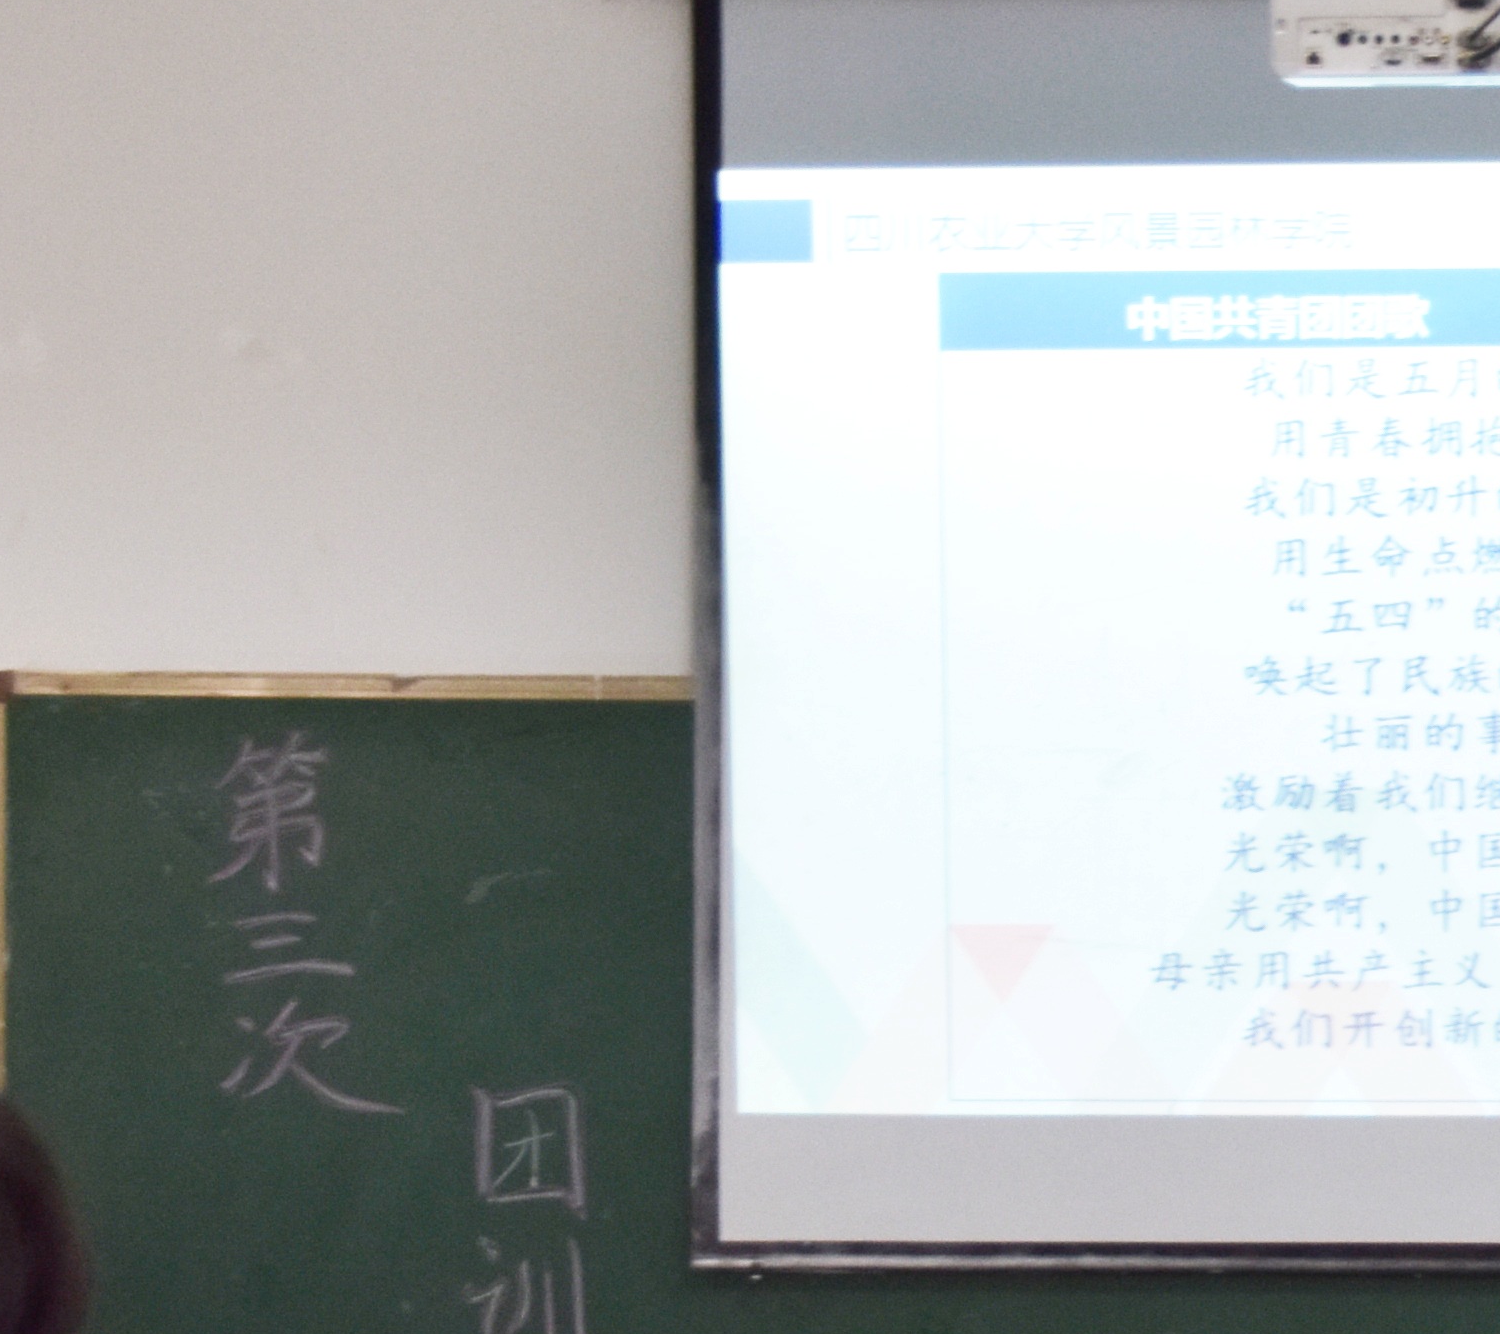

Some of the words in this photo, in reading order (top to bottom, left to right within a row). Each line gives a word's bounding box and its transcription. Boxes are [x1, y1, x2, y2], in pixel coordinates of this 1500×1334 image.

[1126, 293, 1431, 343] 中国共青团团歌
[206, 730, 405, 1117] 第三次
